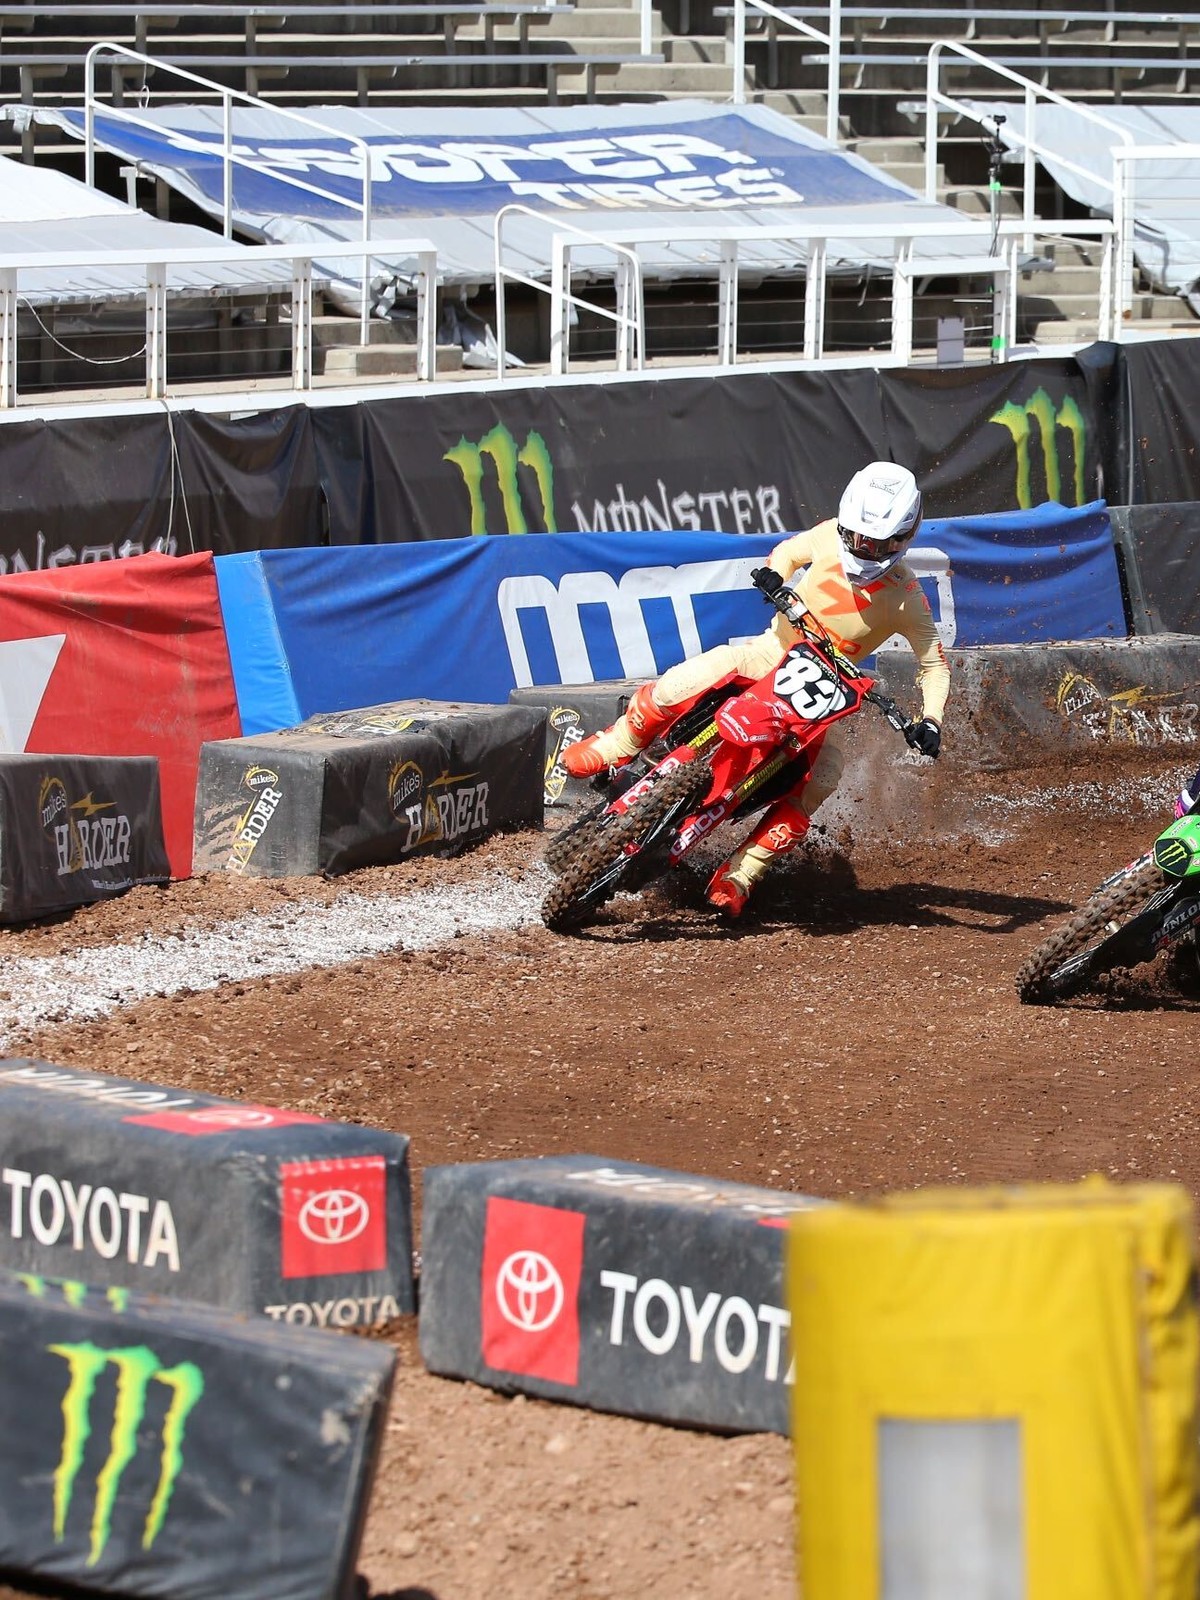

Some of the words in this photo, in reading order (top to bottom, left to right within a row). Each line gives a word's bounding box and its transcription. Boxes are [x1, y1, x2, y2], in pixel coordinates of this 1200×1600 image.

[509, 168, 804, 210] TIRES
[571, 478, 788, 534] MONSTER
[773, 657, 846, 720] 83
[250, 774, 276, 786] mike's
[393, 772, 420, 810] mike's
[54, 815, 131, 876] HARDER
[226, 786, 282, 876] HARDER
[401, 782, 489, 852] HARDER
[670, 803, 725, 855] GEICO
[2, 1168, 181, 1272] TOYOTA
[600, 1270, 797, 1385] TOYOT
